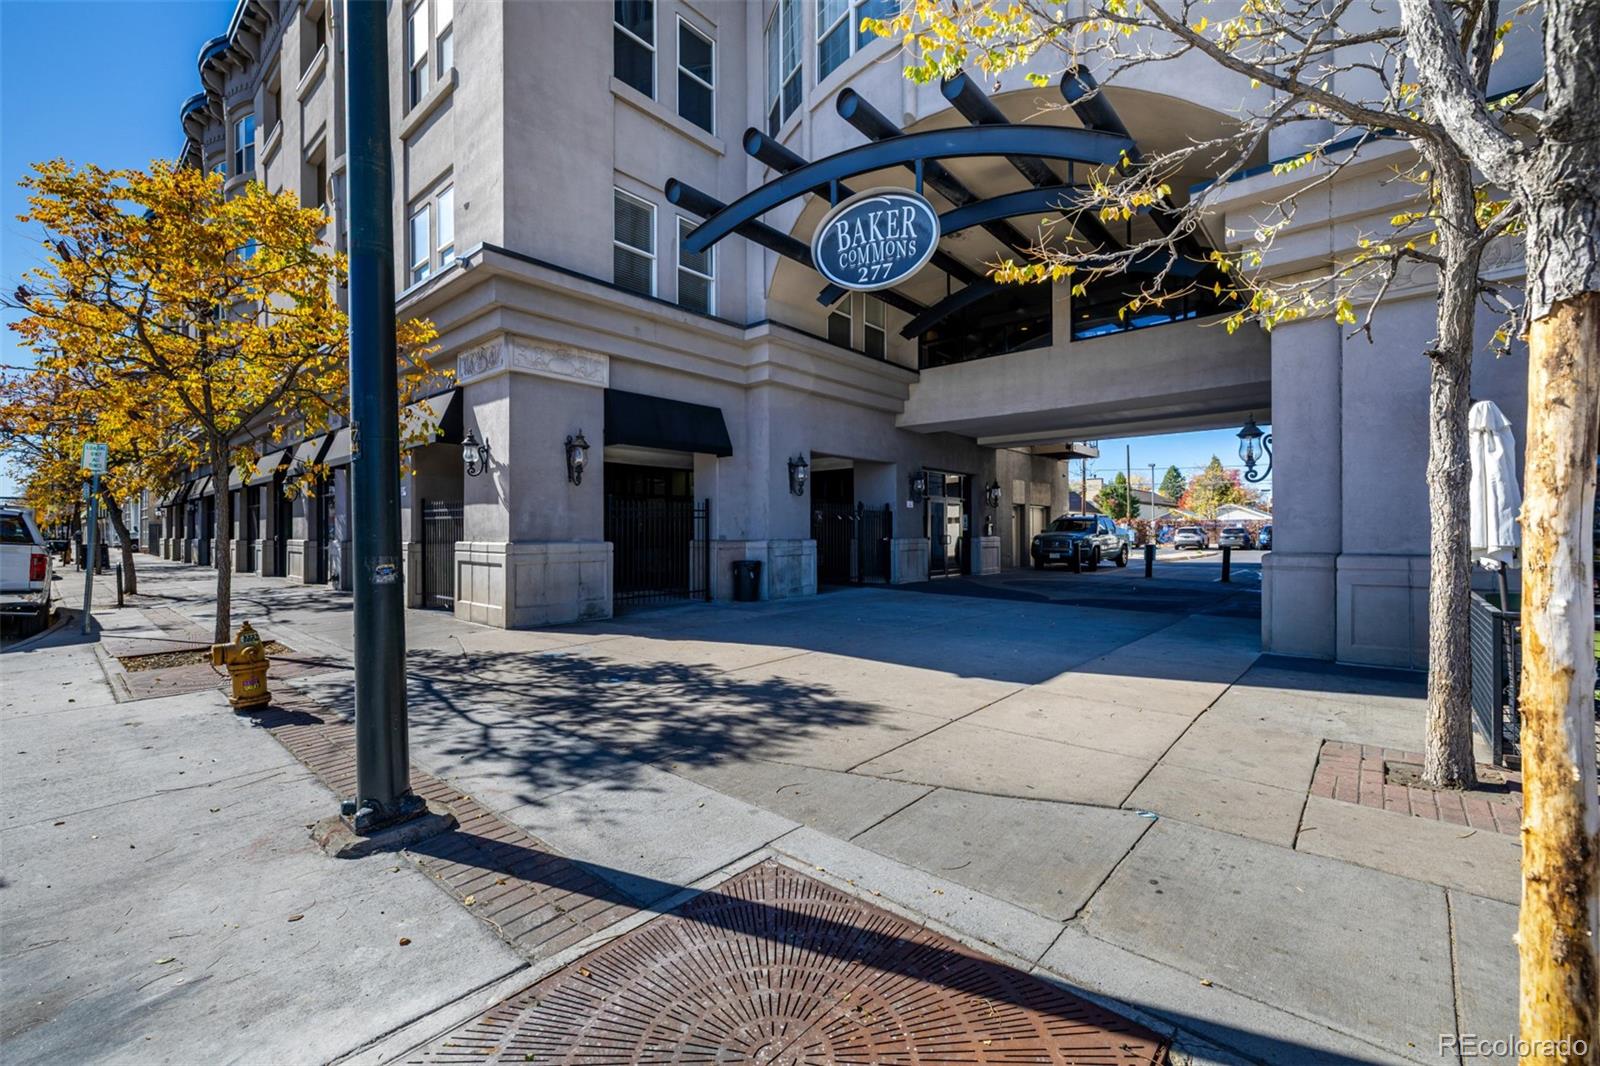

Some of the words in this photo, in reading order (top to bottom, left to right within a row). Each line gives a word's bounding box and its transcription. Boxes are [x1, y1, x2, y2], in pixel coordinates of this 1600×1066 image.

[835, 205, 918, 252] BAKER
[839, 239, 917, 269] COMMONS
[858, 262, 893, 283] 277
